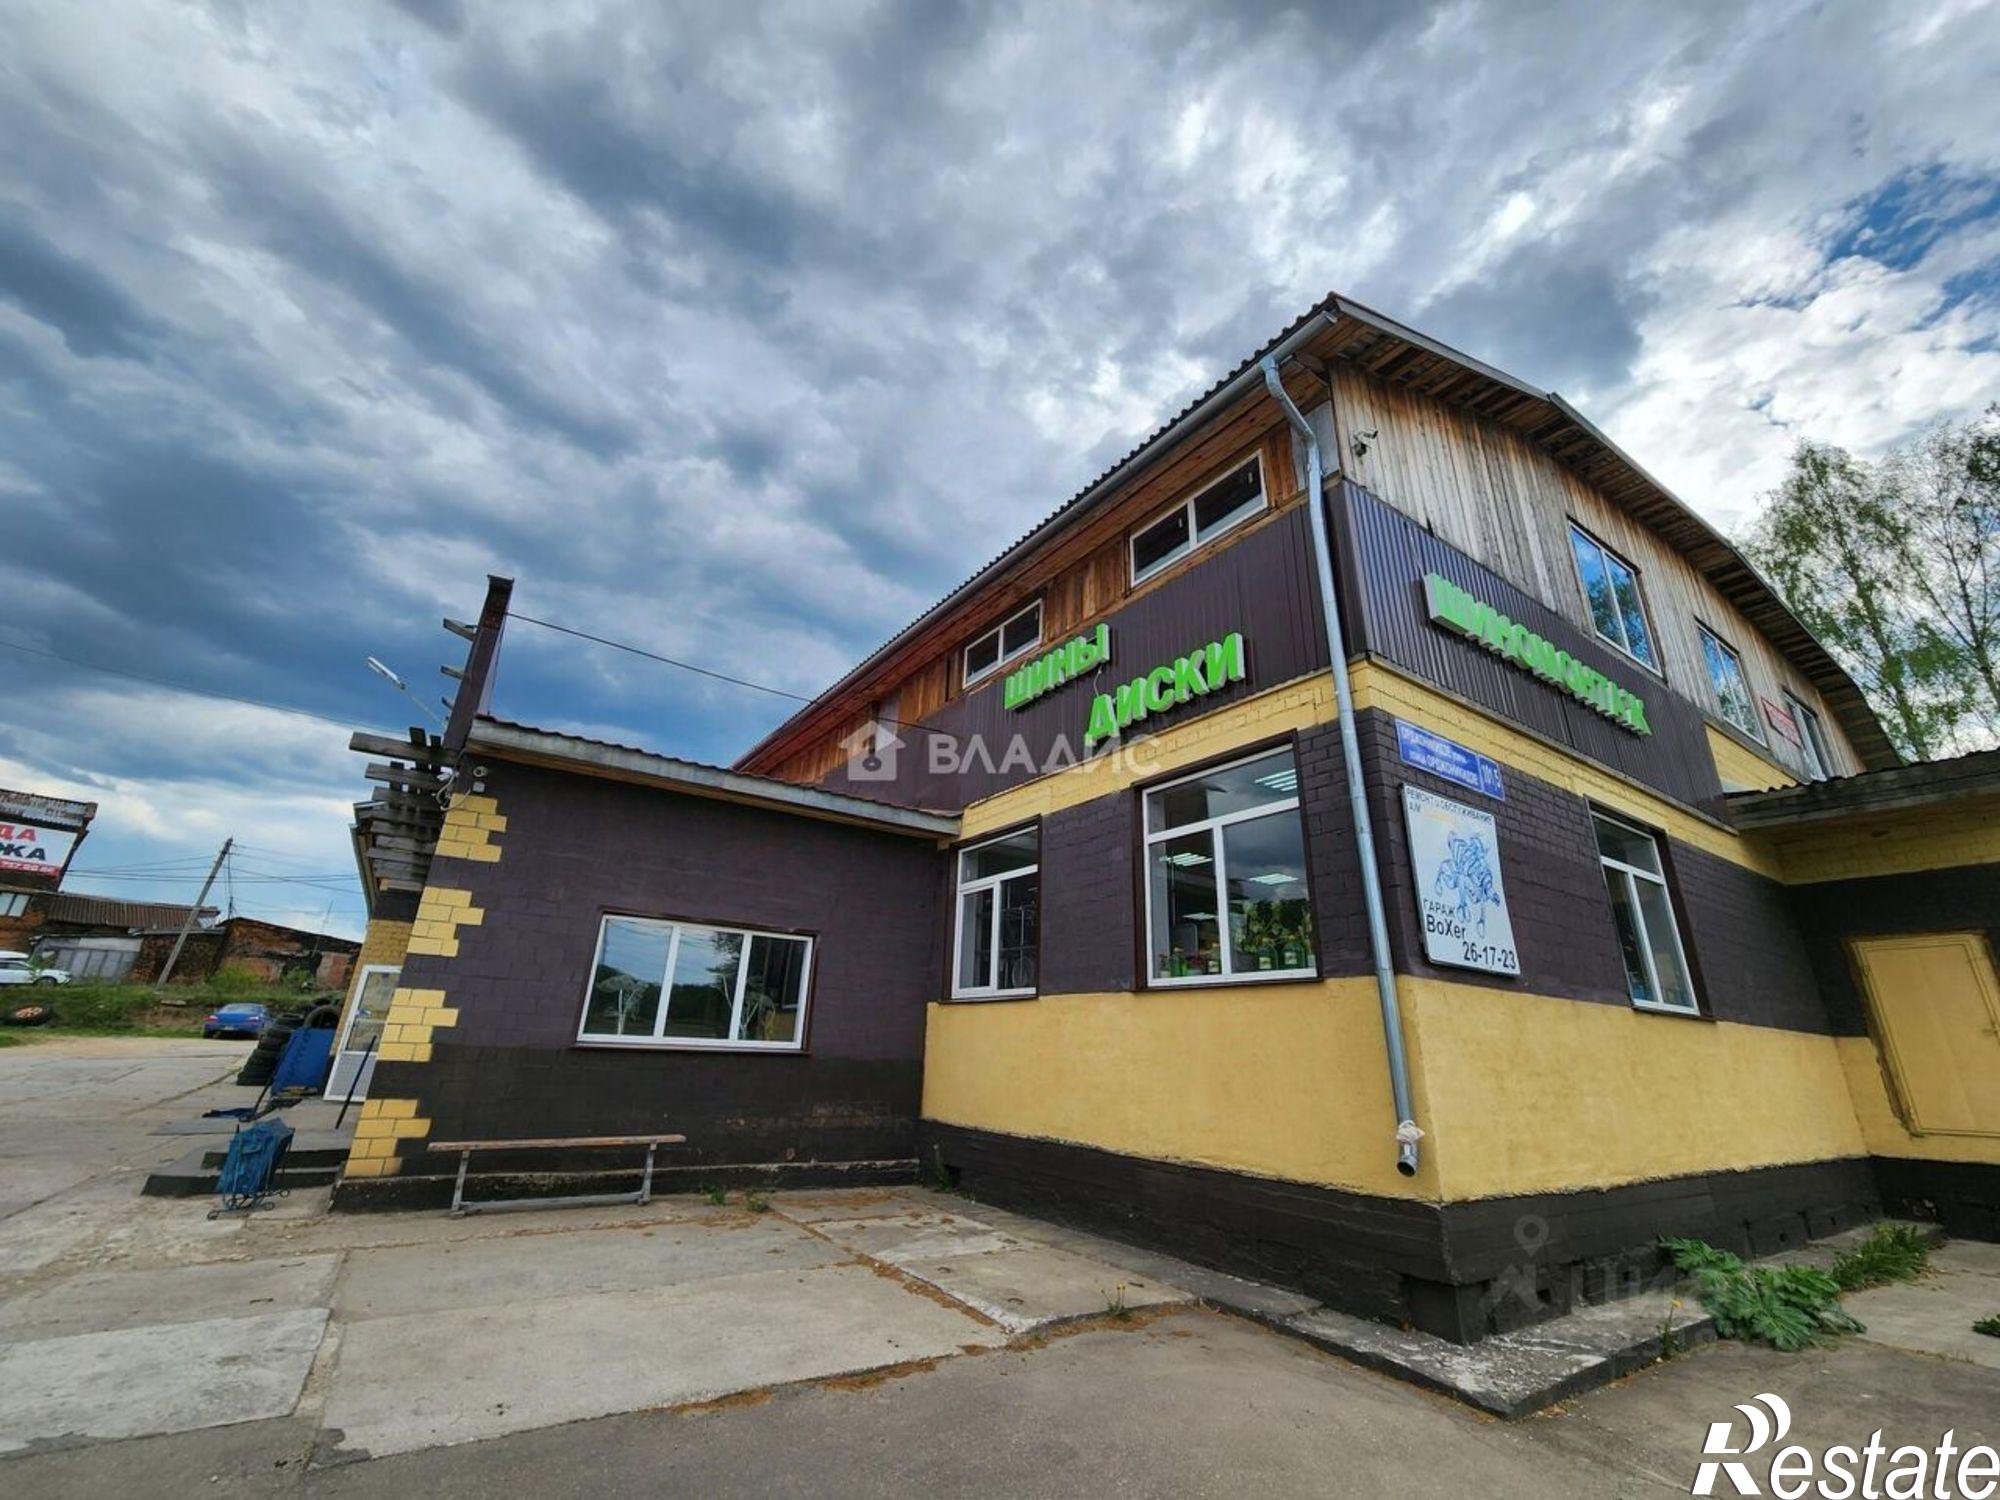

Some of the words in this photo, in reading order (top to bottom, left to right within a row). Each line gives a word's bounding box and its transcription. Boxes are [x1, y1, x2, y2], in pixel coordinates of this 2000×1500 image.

[1004, 623, 1109, 710] ШИНЫ
[1084, 632, 1245, 746] ДИСКИ
[1423, 898, 1456, 918] ГАРАЖ
[1462, 941, 1517, 971] 26-17-23
